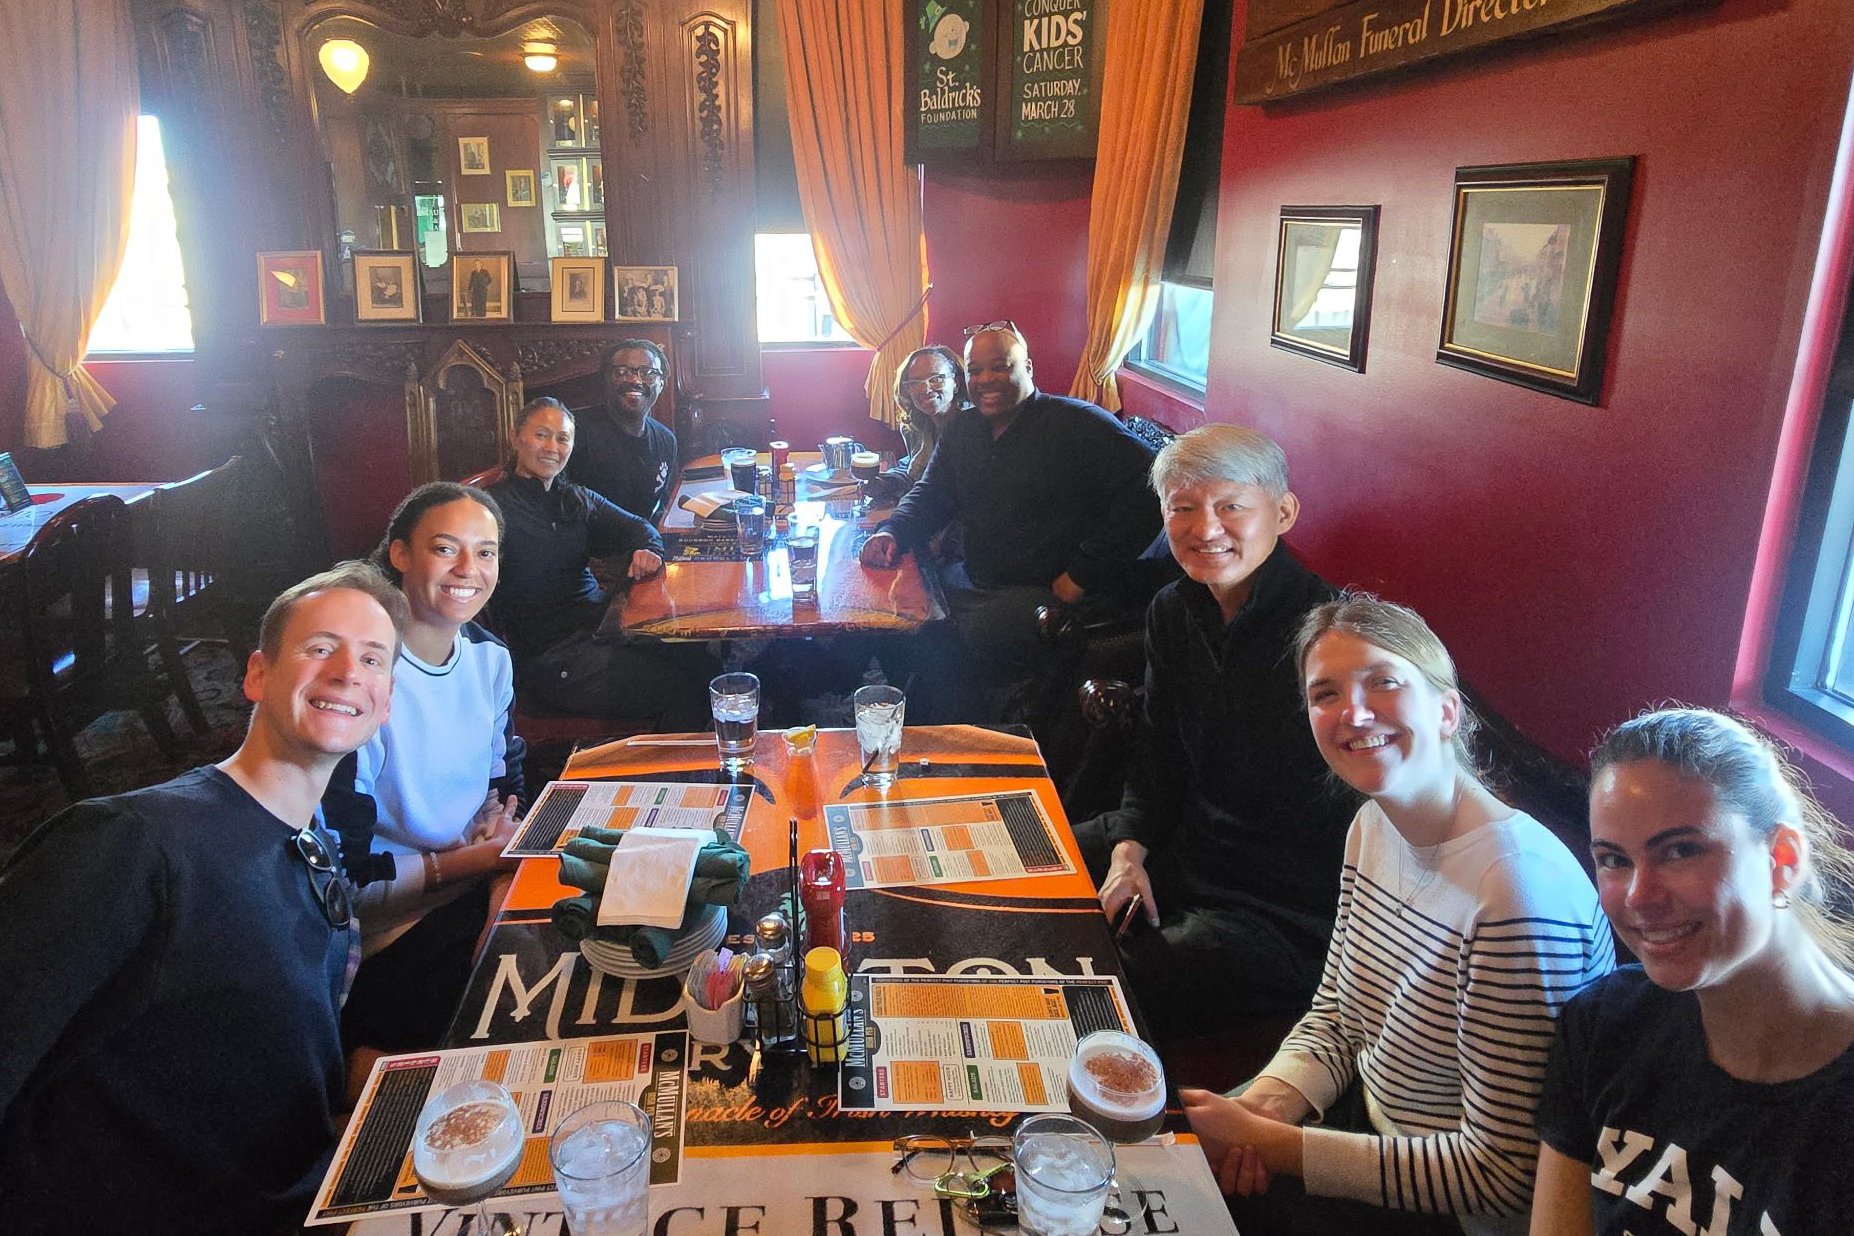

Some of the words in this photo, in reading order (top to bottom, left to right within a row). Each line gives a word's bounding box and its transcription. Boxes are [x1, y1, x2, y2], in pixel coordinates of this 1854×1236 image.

[1023, 11, 1087, 52] KIDS'
[1359, 0, 1430, 58] Funeral
[1440, 0, 1547, 36] Direc
[1023, 46, 1083, 74] CANCER
[936, 66, 959, 87] St.
[920, 82, 981, 111] Baldrick's
[1021, 100, 1059, 120] MARCH
[1060, 99, 1075, 118] 28
[921, 108, 977, 123] FOUNDATION
[851, 931, 876, 944] 25
[686, 1095, 763, 1122] nacle
[763, 1097, 808, 1129] of
[1591, 1126, 1782, 1236] YAL
[408, 1206, 765, 1236] VINTGE
[805, 1189, 1180, 1236] RELSE
